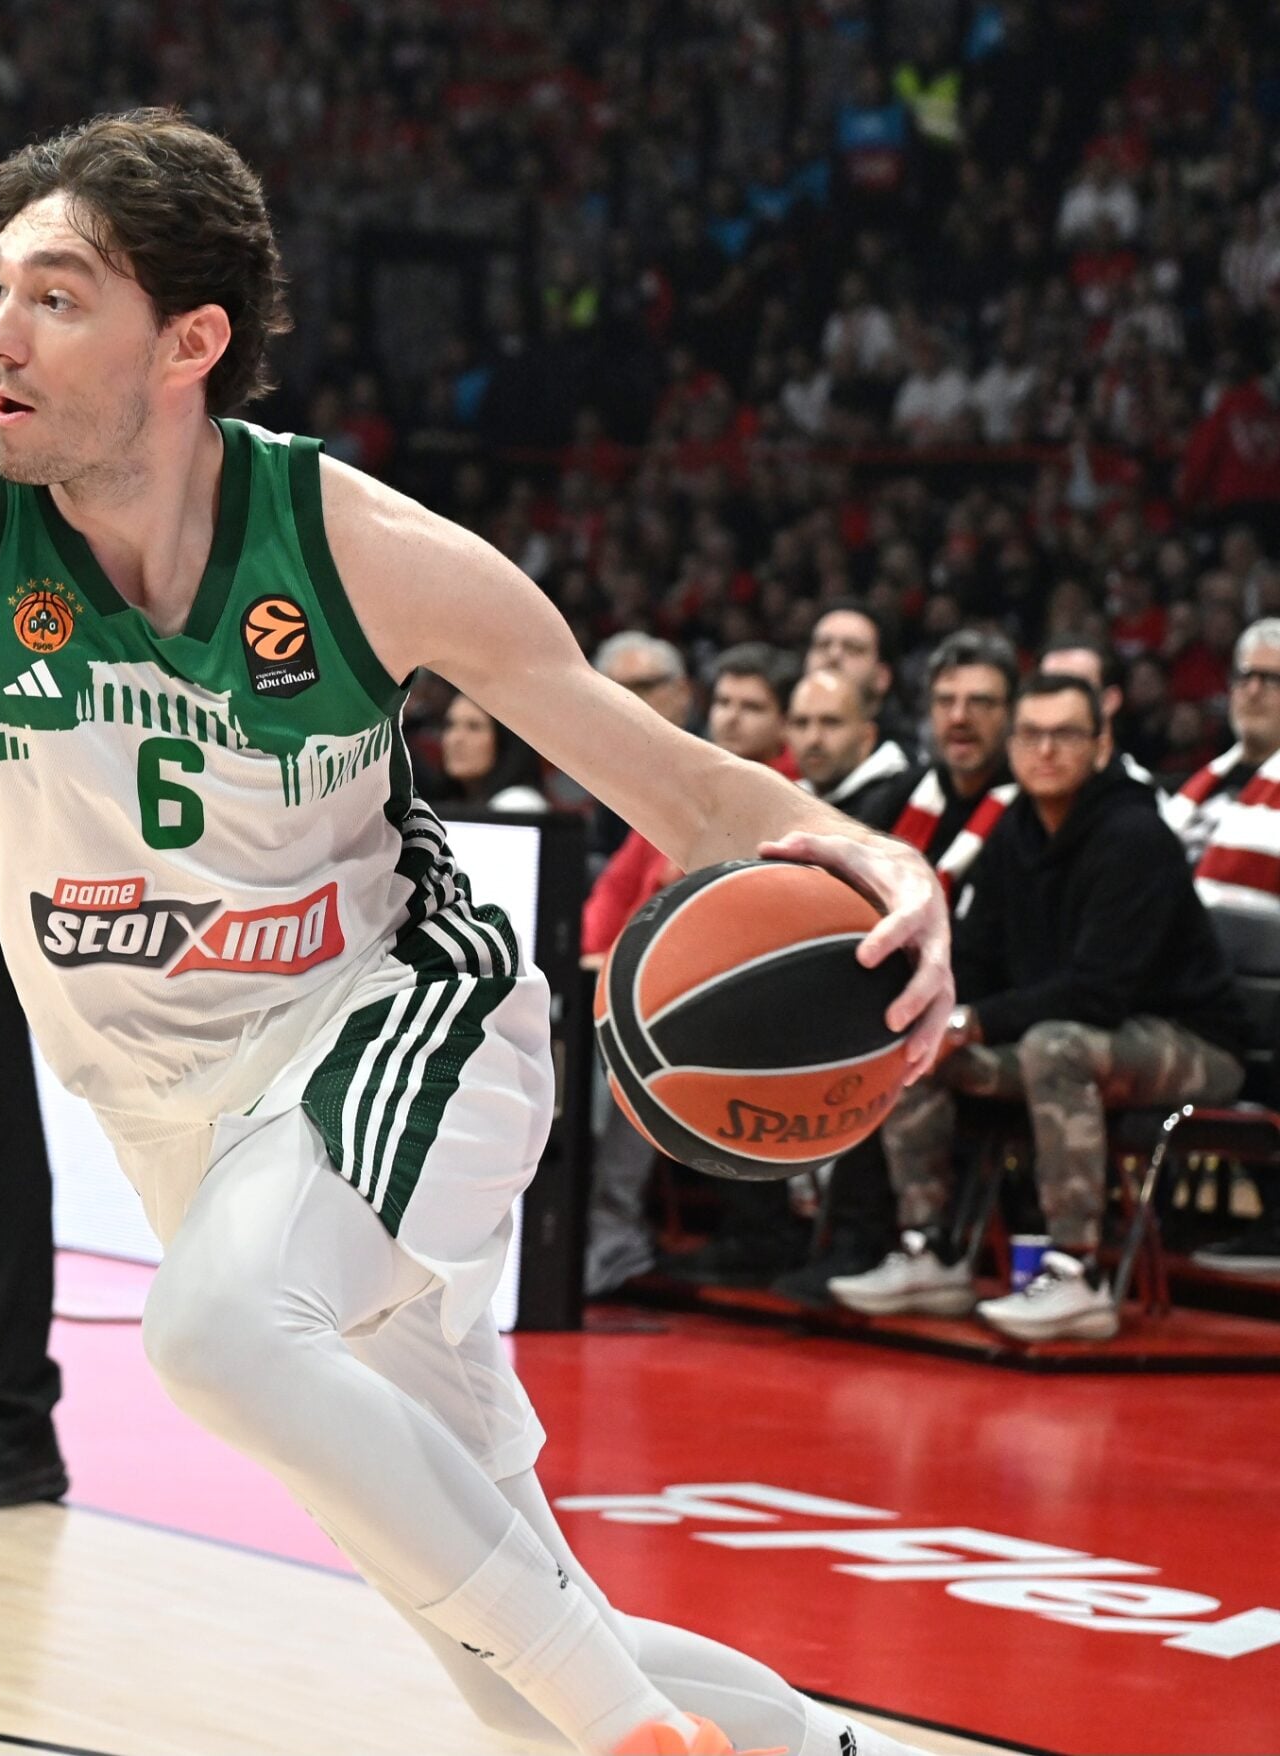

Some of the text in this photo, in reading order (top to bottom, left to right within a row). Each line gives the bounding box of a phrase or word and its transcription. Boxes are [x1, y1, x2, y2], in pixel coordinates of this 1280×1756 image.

[256, 668, 316, 690] abu dhabi
[137, 737, 205, 850] 6
[61, 883, 136, 905] pame
